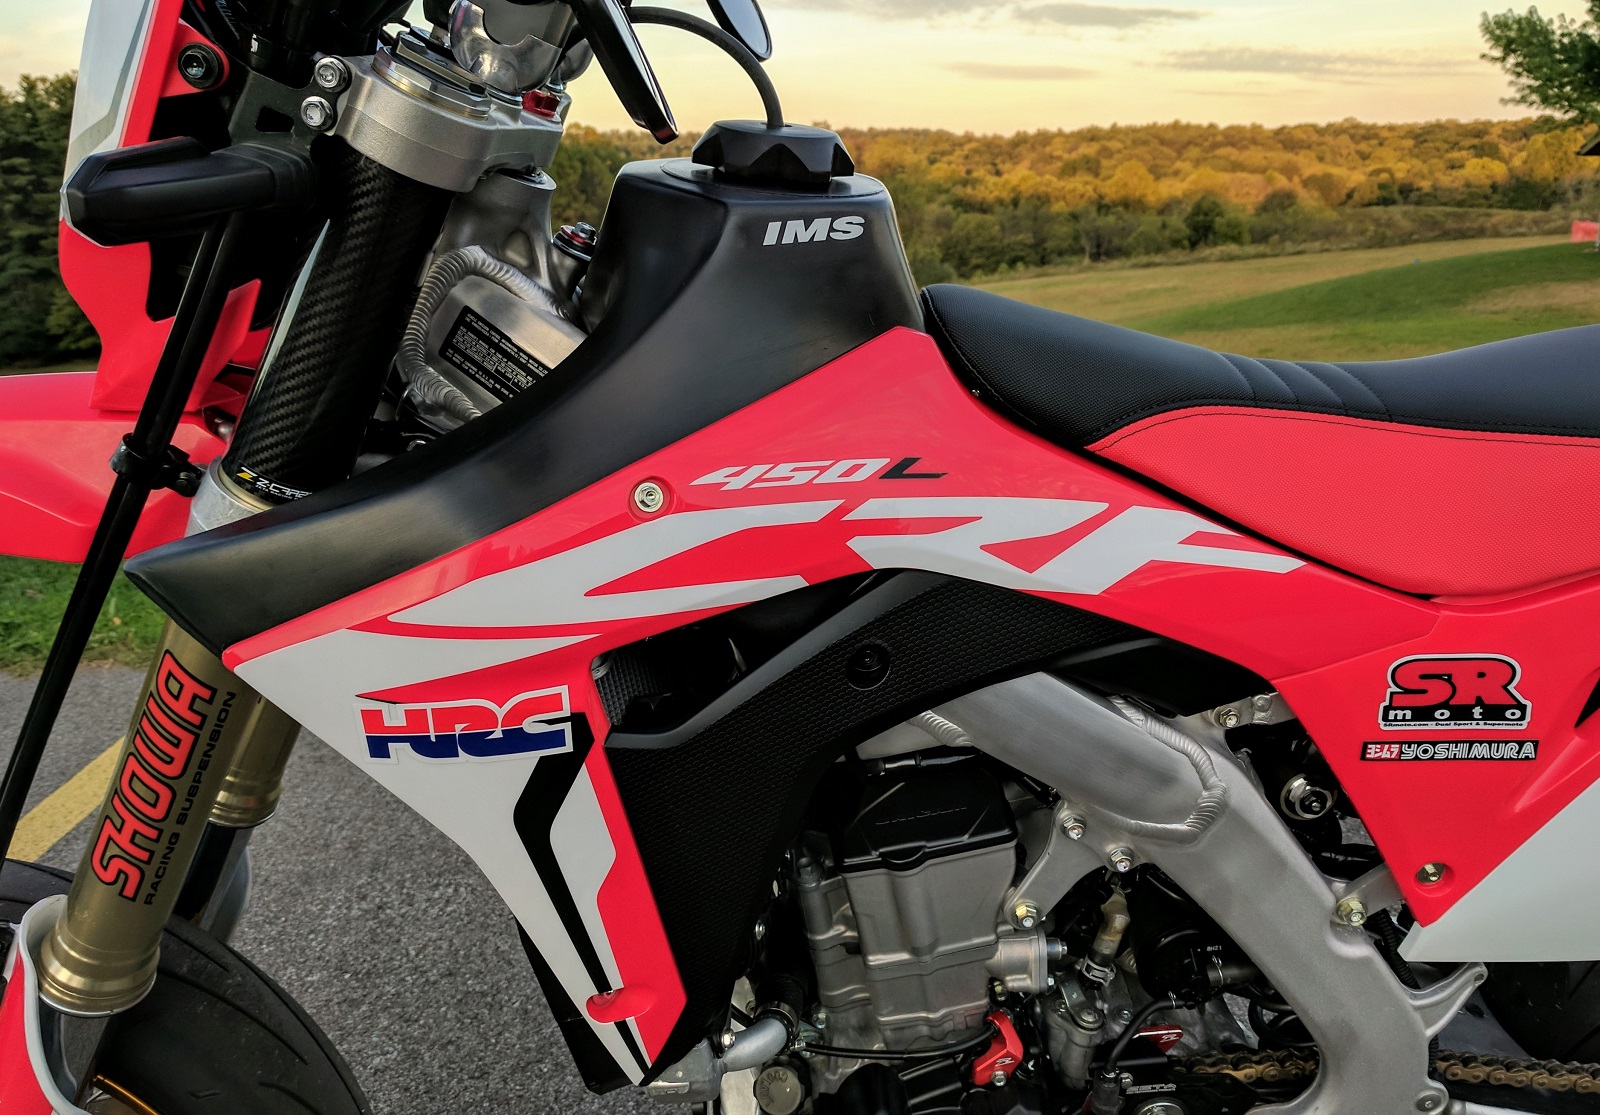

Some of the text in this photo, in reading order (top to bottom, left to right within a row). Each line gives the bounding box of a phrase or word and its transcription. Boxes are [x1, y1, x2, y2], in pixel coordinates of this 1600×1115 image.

[763, 216, 865, 246] IMS
[689, 457, 948, 491] 450L
[387, 496, 1308, 626] CRF
[1391, 657, 1522, 707] SR
[359, 689, 569, 761] HRC
[91, 649, 217, 902] SHOWA
[1366, 744, 1400, 759] ヨシムラ
[1400, 742, 1536, 760] YOSHIMURA
[143, 691, 236, 906] RACING SUSPENSION
